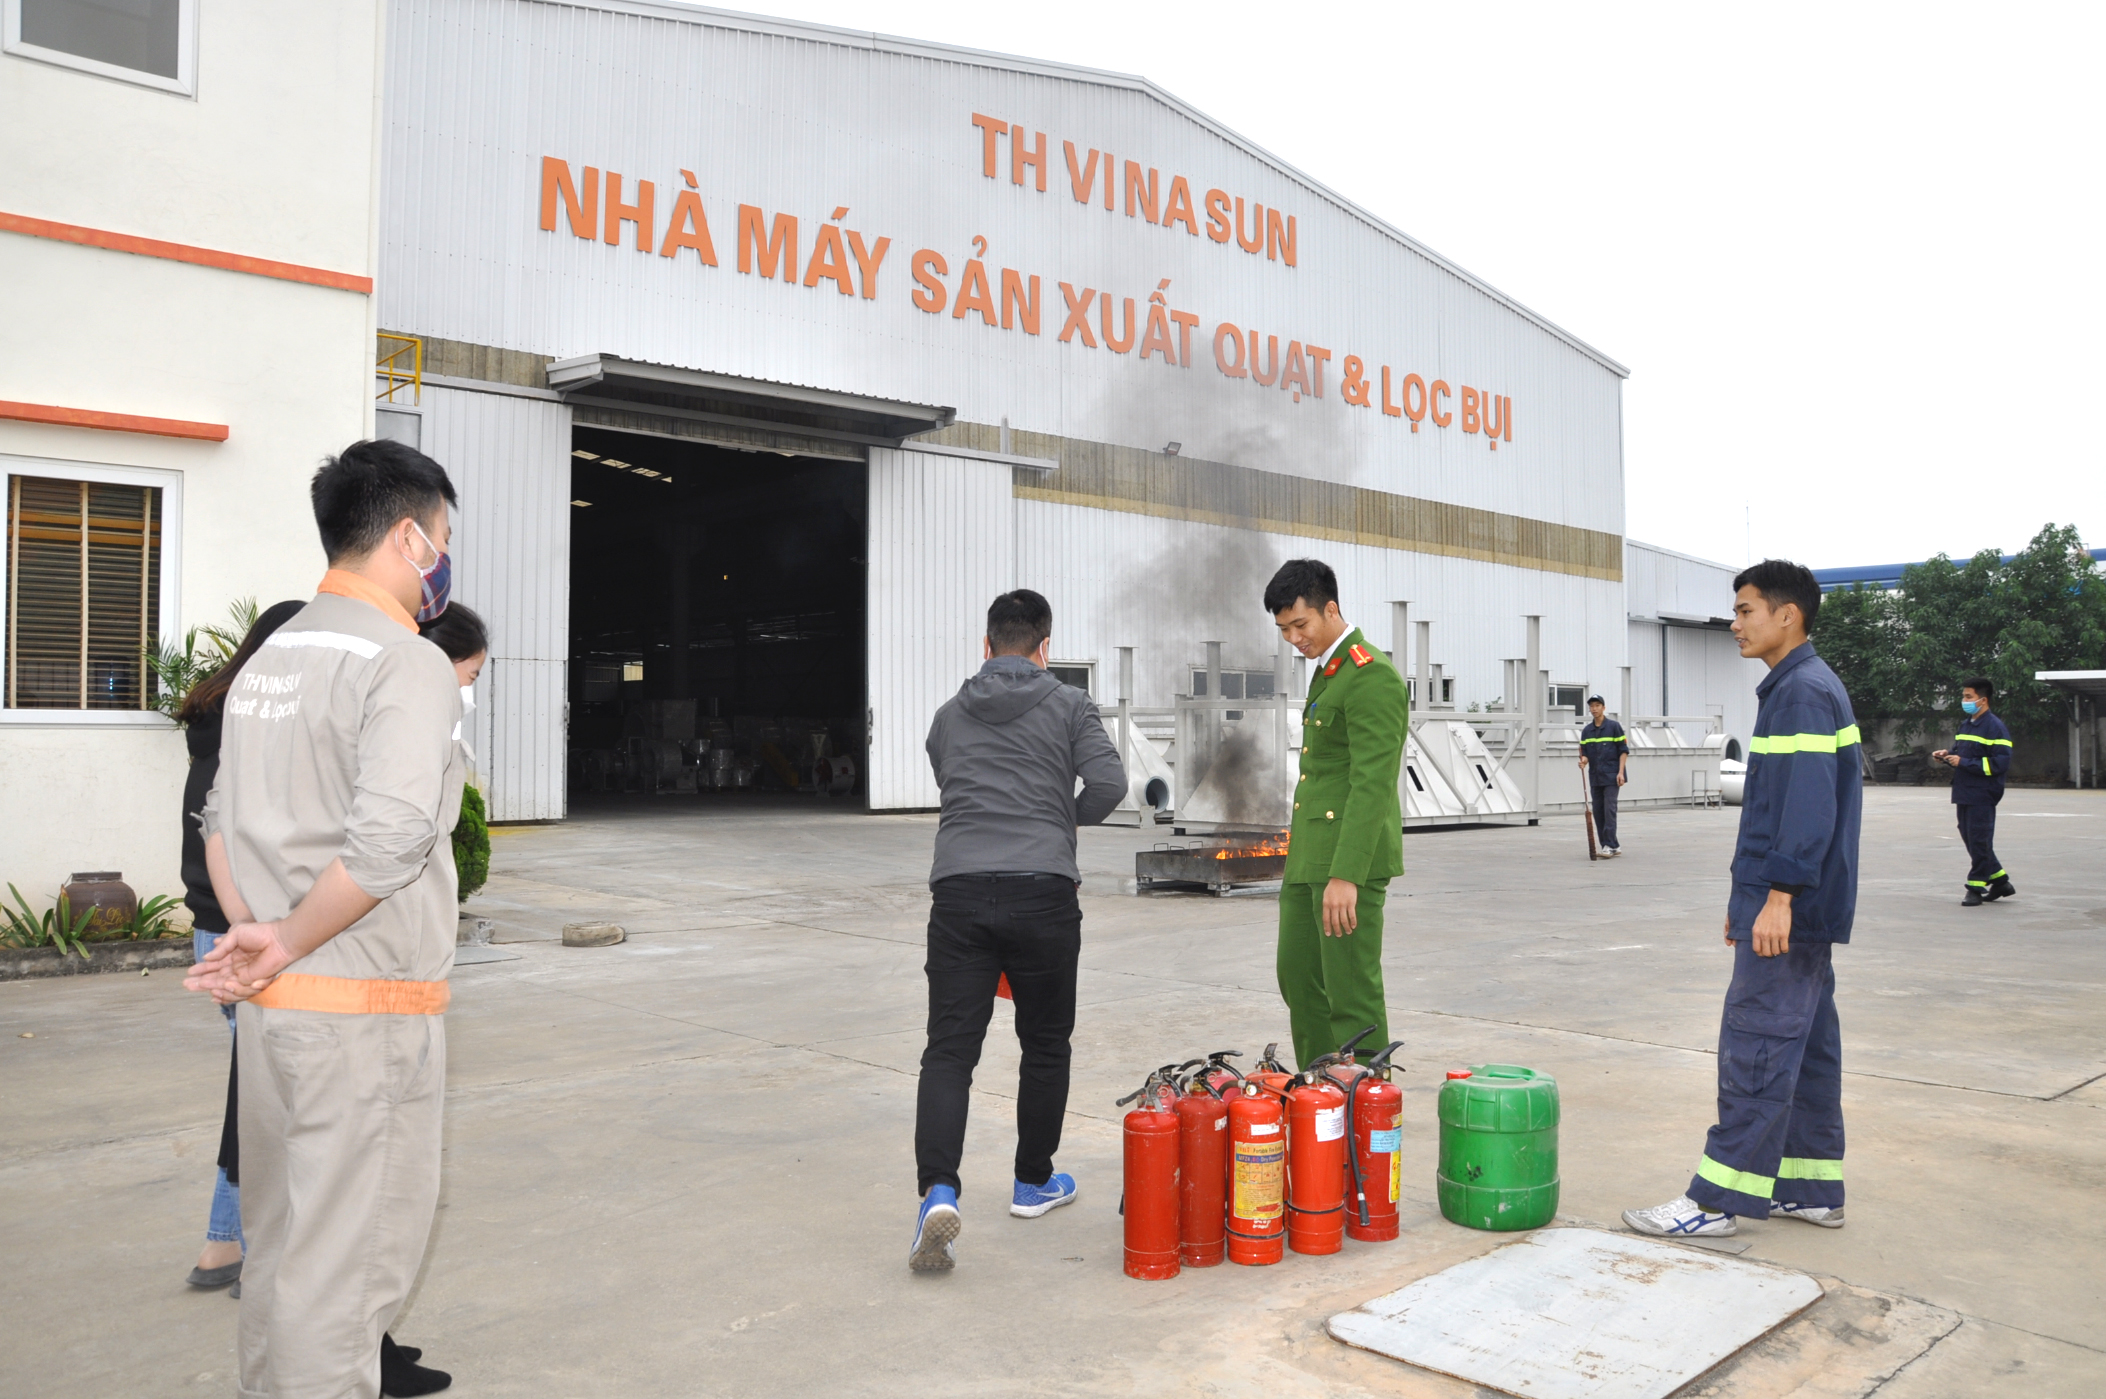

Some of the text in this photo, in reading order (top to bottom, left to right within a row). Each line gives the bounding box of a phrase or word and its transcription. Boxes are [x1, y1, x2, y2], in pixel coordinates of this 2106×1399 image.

[971, 112, 1297, 268] TH VINASUN
[540, 155, 1513, 451] NHÀ MÁY SẢN XUẤT QUẠT & LỌC BỤI
[259, 700, 271, 719] &
